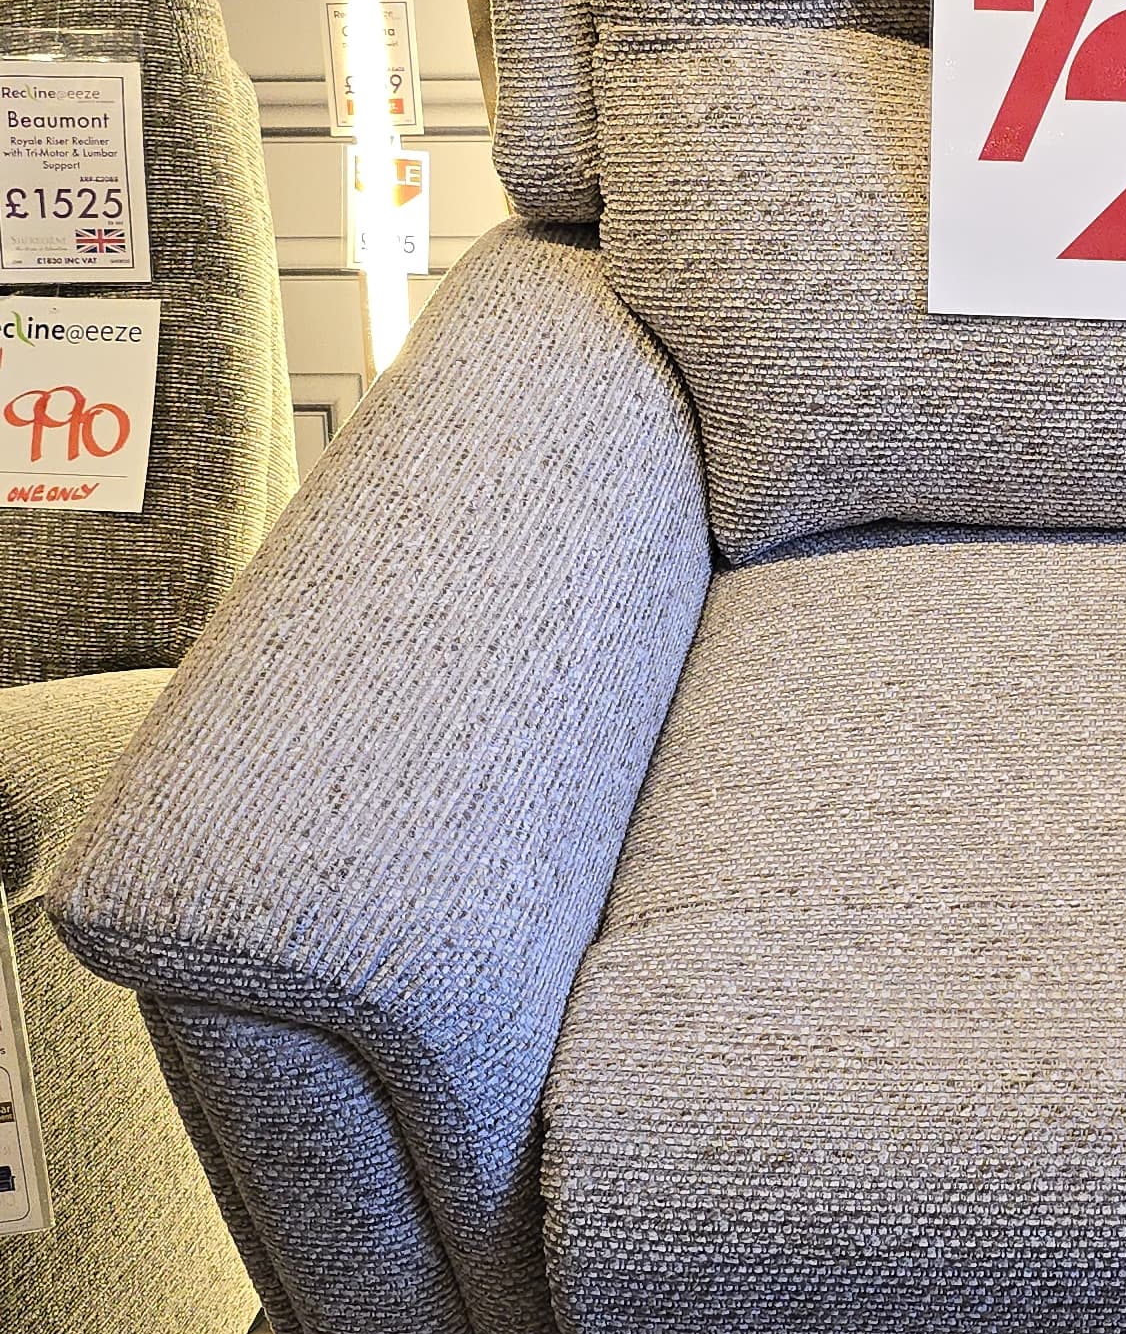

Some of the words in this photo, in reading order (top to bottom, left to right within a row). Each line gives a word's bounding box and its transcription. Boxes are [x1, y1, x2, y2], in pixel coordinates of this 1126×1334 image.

[8, 110, 110, 128] Beaumont
[10, 136, 42, 147] Royale
[46, 136, 69, 145] Riser
[72, 136, 109, 146] Recliner
[3, 148, 22, 157] with
[26, 148, 68, 157] Tri-Motor
[72, 148, 79, 157] &
[83, 148, 118, 157] Lumbar
[43, 160, 80, 171] Support
[5, 187, 123, 219] £1525
[3, 385, 131, 463] 990
[7, 483, 46, 503] ONE
[46, 482, 100, 502] ONLY
